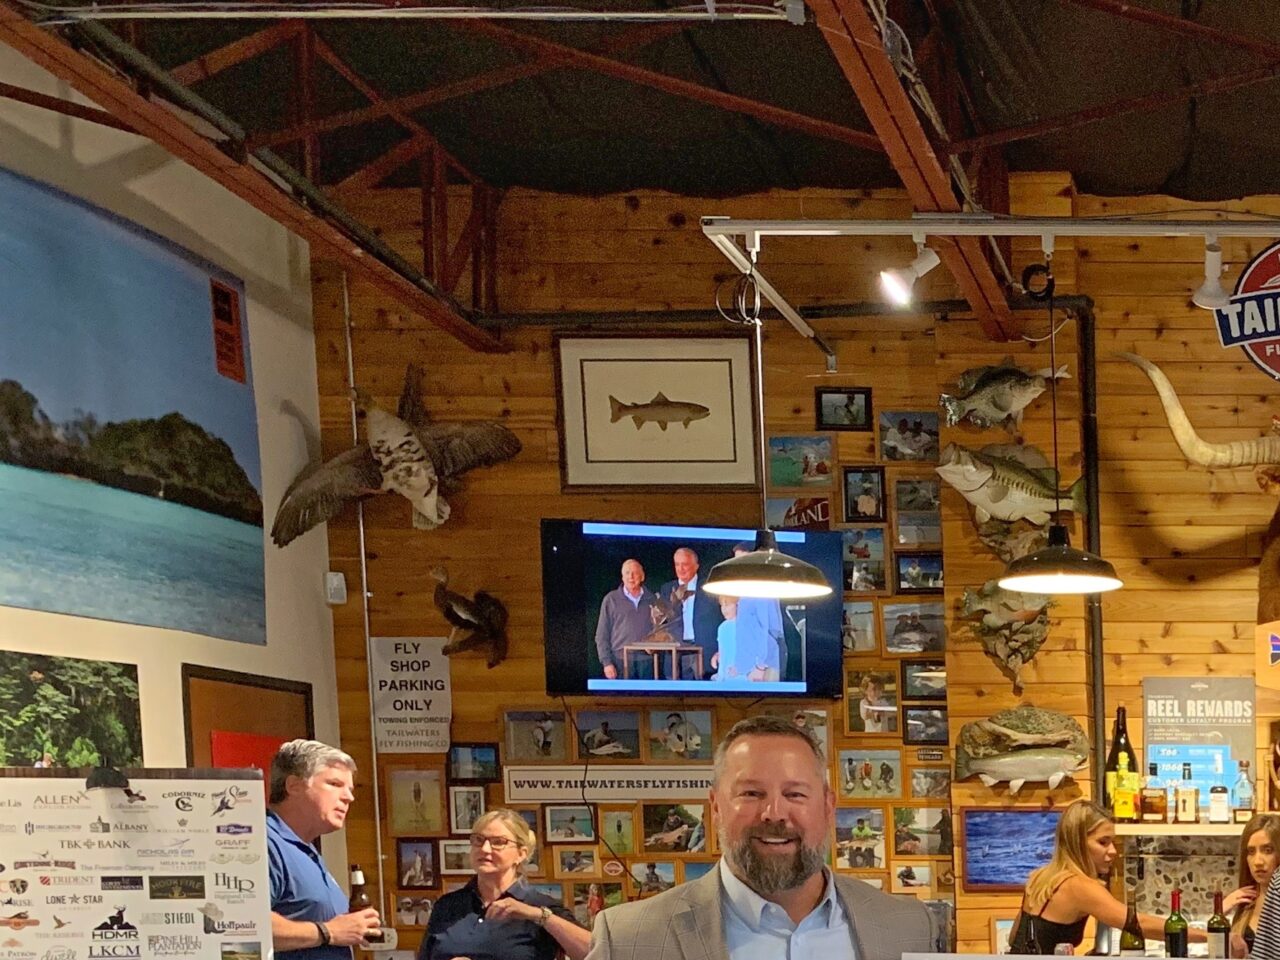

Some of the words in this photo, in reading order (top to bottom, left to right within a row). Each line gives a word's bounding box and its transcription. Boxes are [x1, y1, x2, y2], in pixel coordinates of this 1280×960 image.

[394, 643, 421, 654] FLY
[390, 660, 431, 672] SHOP
[378, 680, 446, 691] PARKING
[392, 699, 433, 711] ONLY
[1147, 700, 1182, 717] REEL
[1187, 700, 1252, 717] REWARDS
[386, 729, 440, 737] TAILWATERS
[60, 840, 82, 849] TBK
[98, 840, 132, 849] BANK
[46, 895, 66, 905] LONE
[83, 895, 104, 904] STAR
[92, 930, 139, 940] HDMR
[158, 935, 180, 945] PINE
[181, 934, 199, 945] HILL
[88, 945, 141, 957] LKCM
[148, 943, 202, 952] PLANTATION
